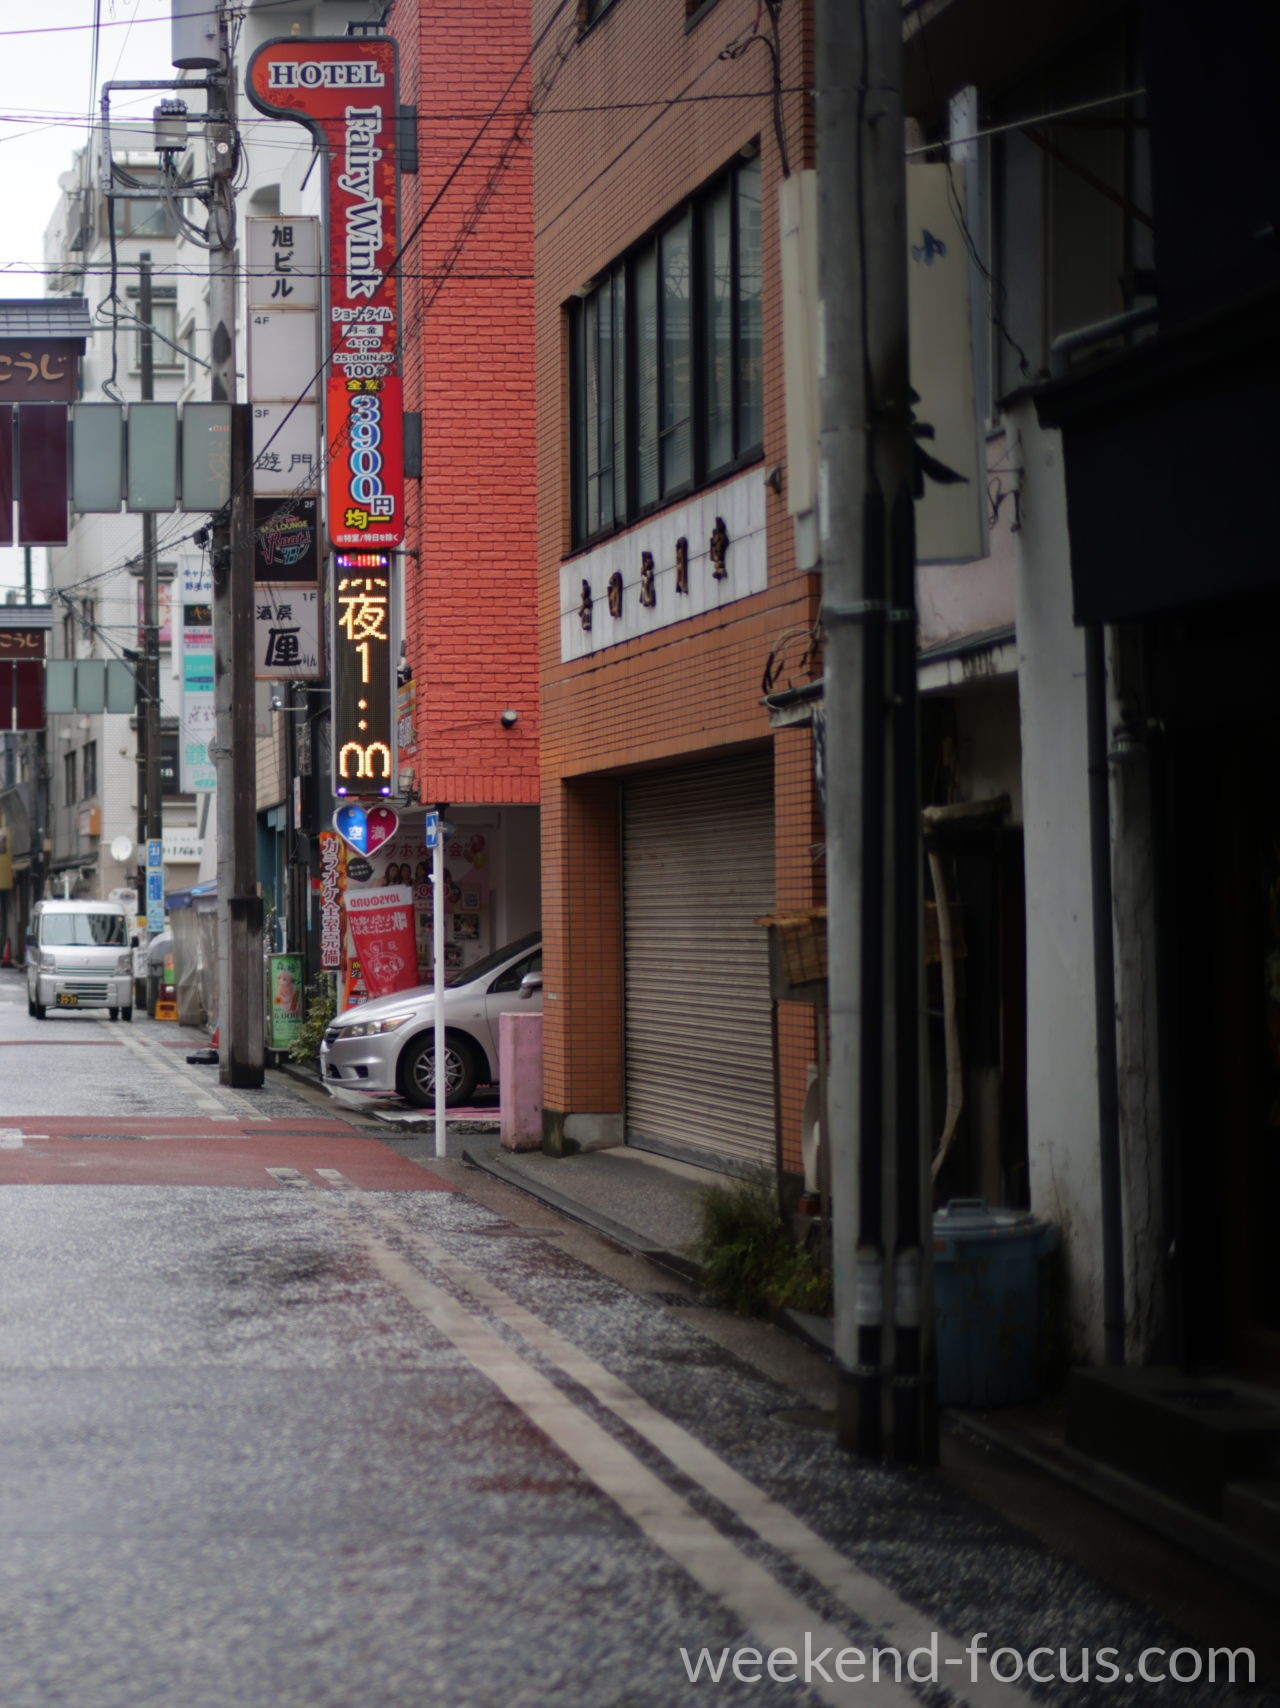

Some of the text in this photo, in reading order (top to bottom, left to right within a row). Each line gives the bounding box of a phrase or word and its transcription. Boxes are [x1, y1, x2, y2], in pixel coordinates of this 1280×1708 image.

[269, 62, 384, 87] HOTEL
[271, 225, 294, 298] 旭ビル
[254, 316, 269, 325] 4F
[255, 409, 269, 418] 3F
[304, 500, 315, 509] 2F
[345, 508, 390, 529] 均一
[303, 593, 317, 601] 1F
[256, 605, 293, 621] 酒房
[349, 826, 386, 840] 空 満
